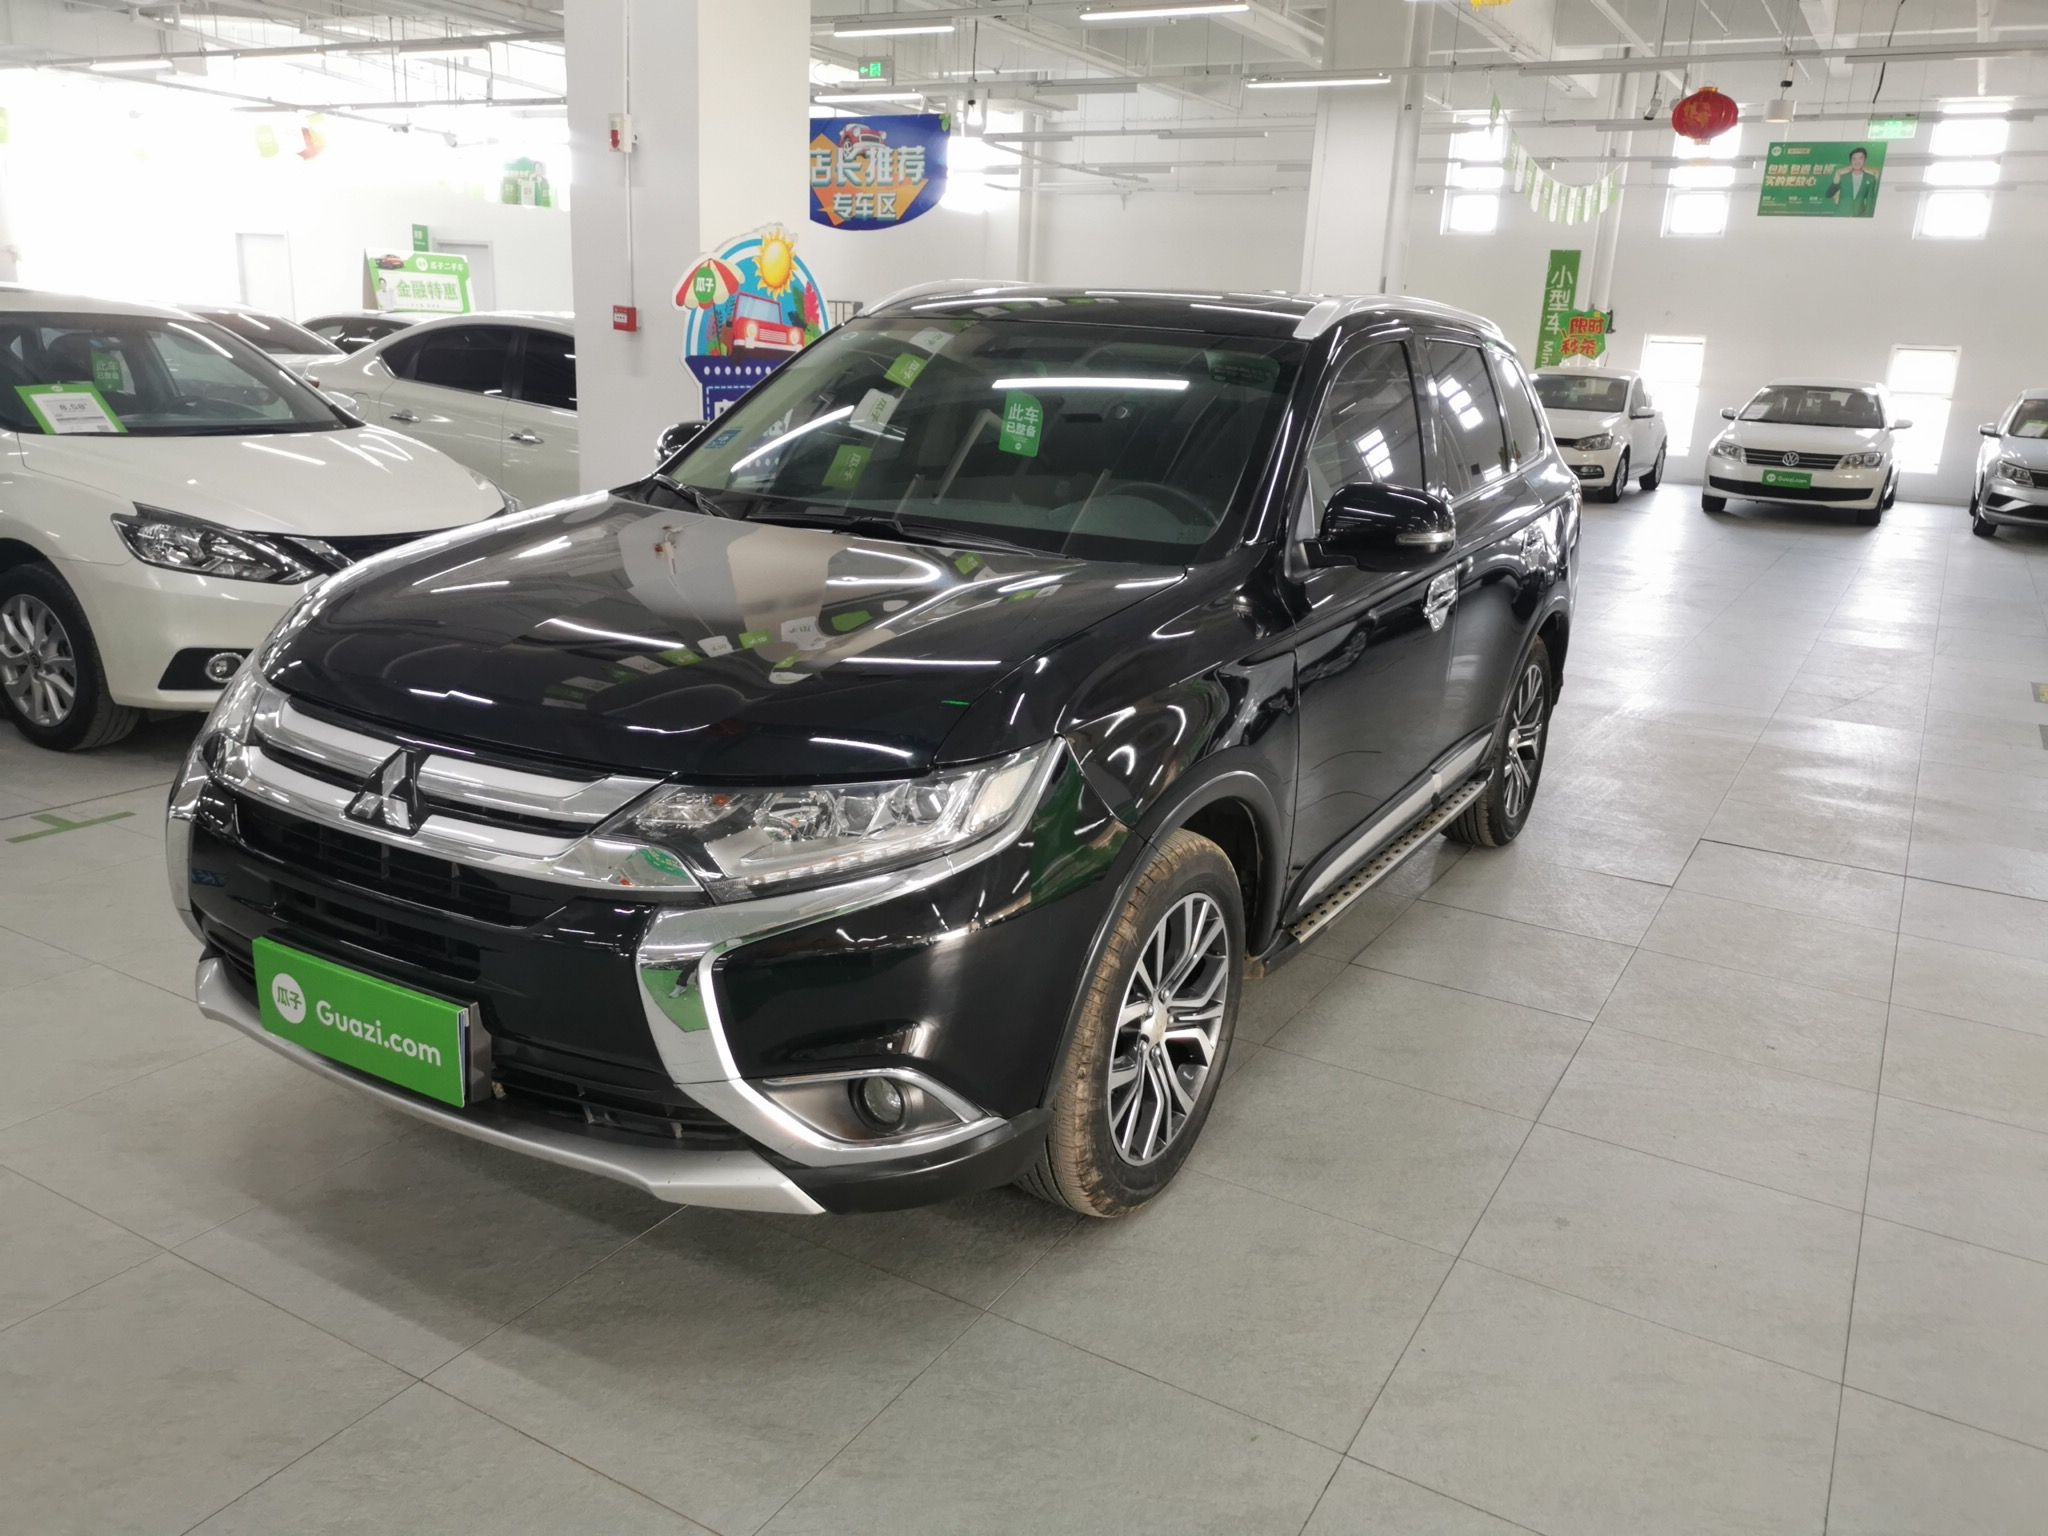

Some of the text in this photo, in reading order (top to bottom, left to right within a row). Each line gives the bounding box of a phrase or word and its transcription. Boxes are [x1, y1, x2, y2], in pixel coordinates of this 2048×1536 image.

[810, 145, 926, 188] 店长推荐
[833, 192, 897, 219] 专车区
[695, 277, 714, 293] 瓜子
[1008, 403, 1039, 424] 此车
[277, 986, 302, 1010] 瓜子
[316, 1000, 441, 1066] Guazi.com
